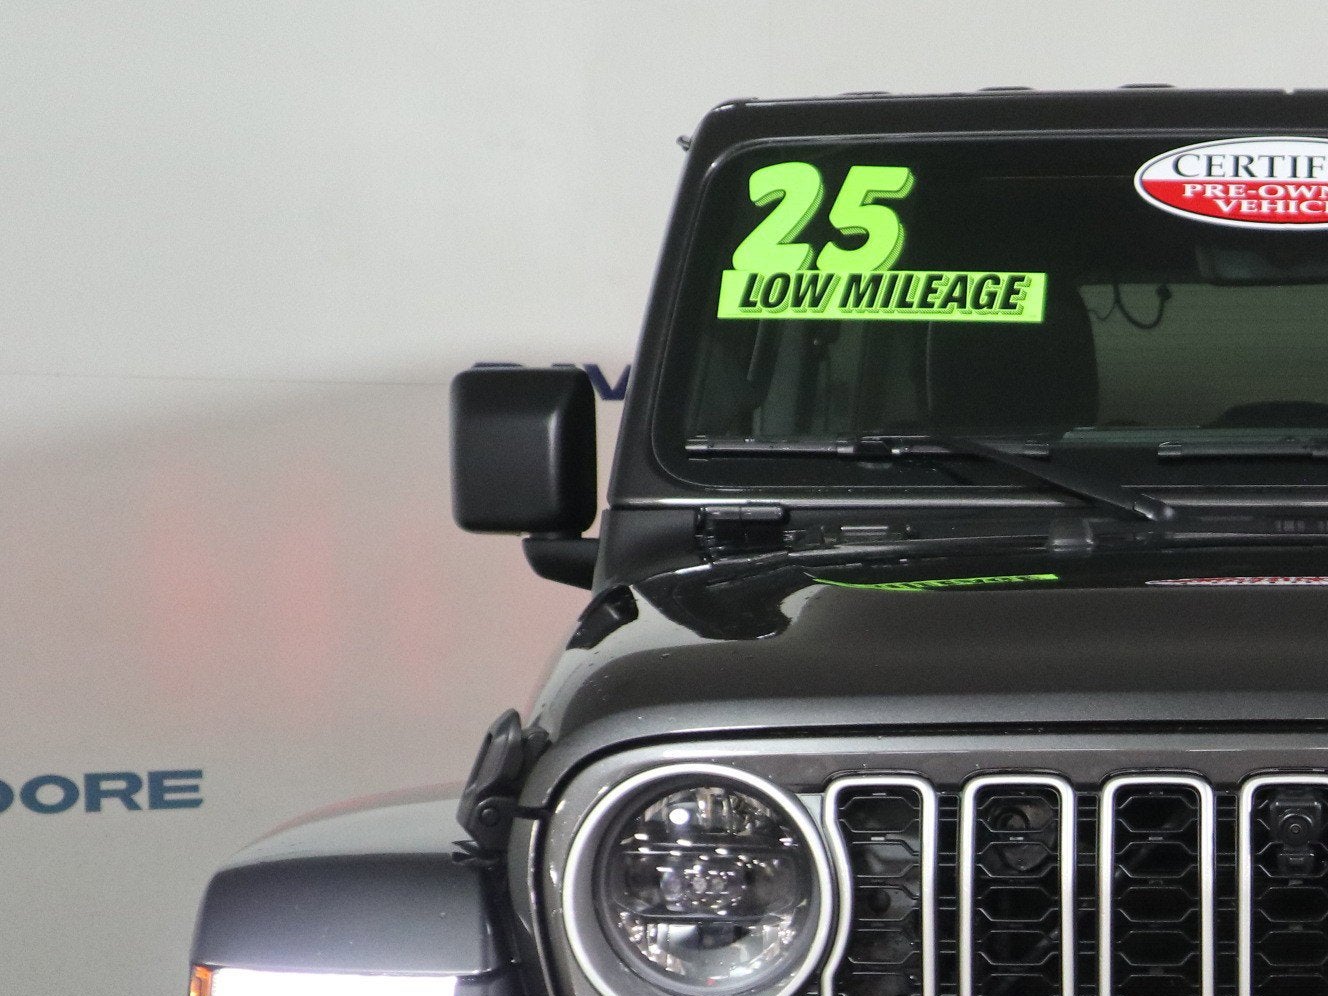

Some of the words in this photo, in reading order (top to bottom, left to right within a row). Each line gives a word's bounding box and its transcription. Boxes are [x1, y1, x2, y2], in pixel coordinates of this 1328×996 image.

[732, 162, 916, 270] 25
[738, 271, 840, 312] LOW
[839, 272, 1031, 315] MILEAGE
[0, 769, 203, 814] ORE
